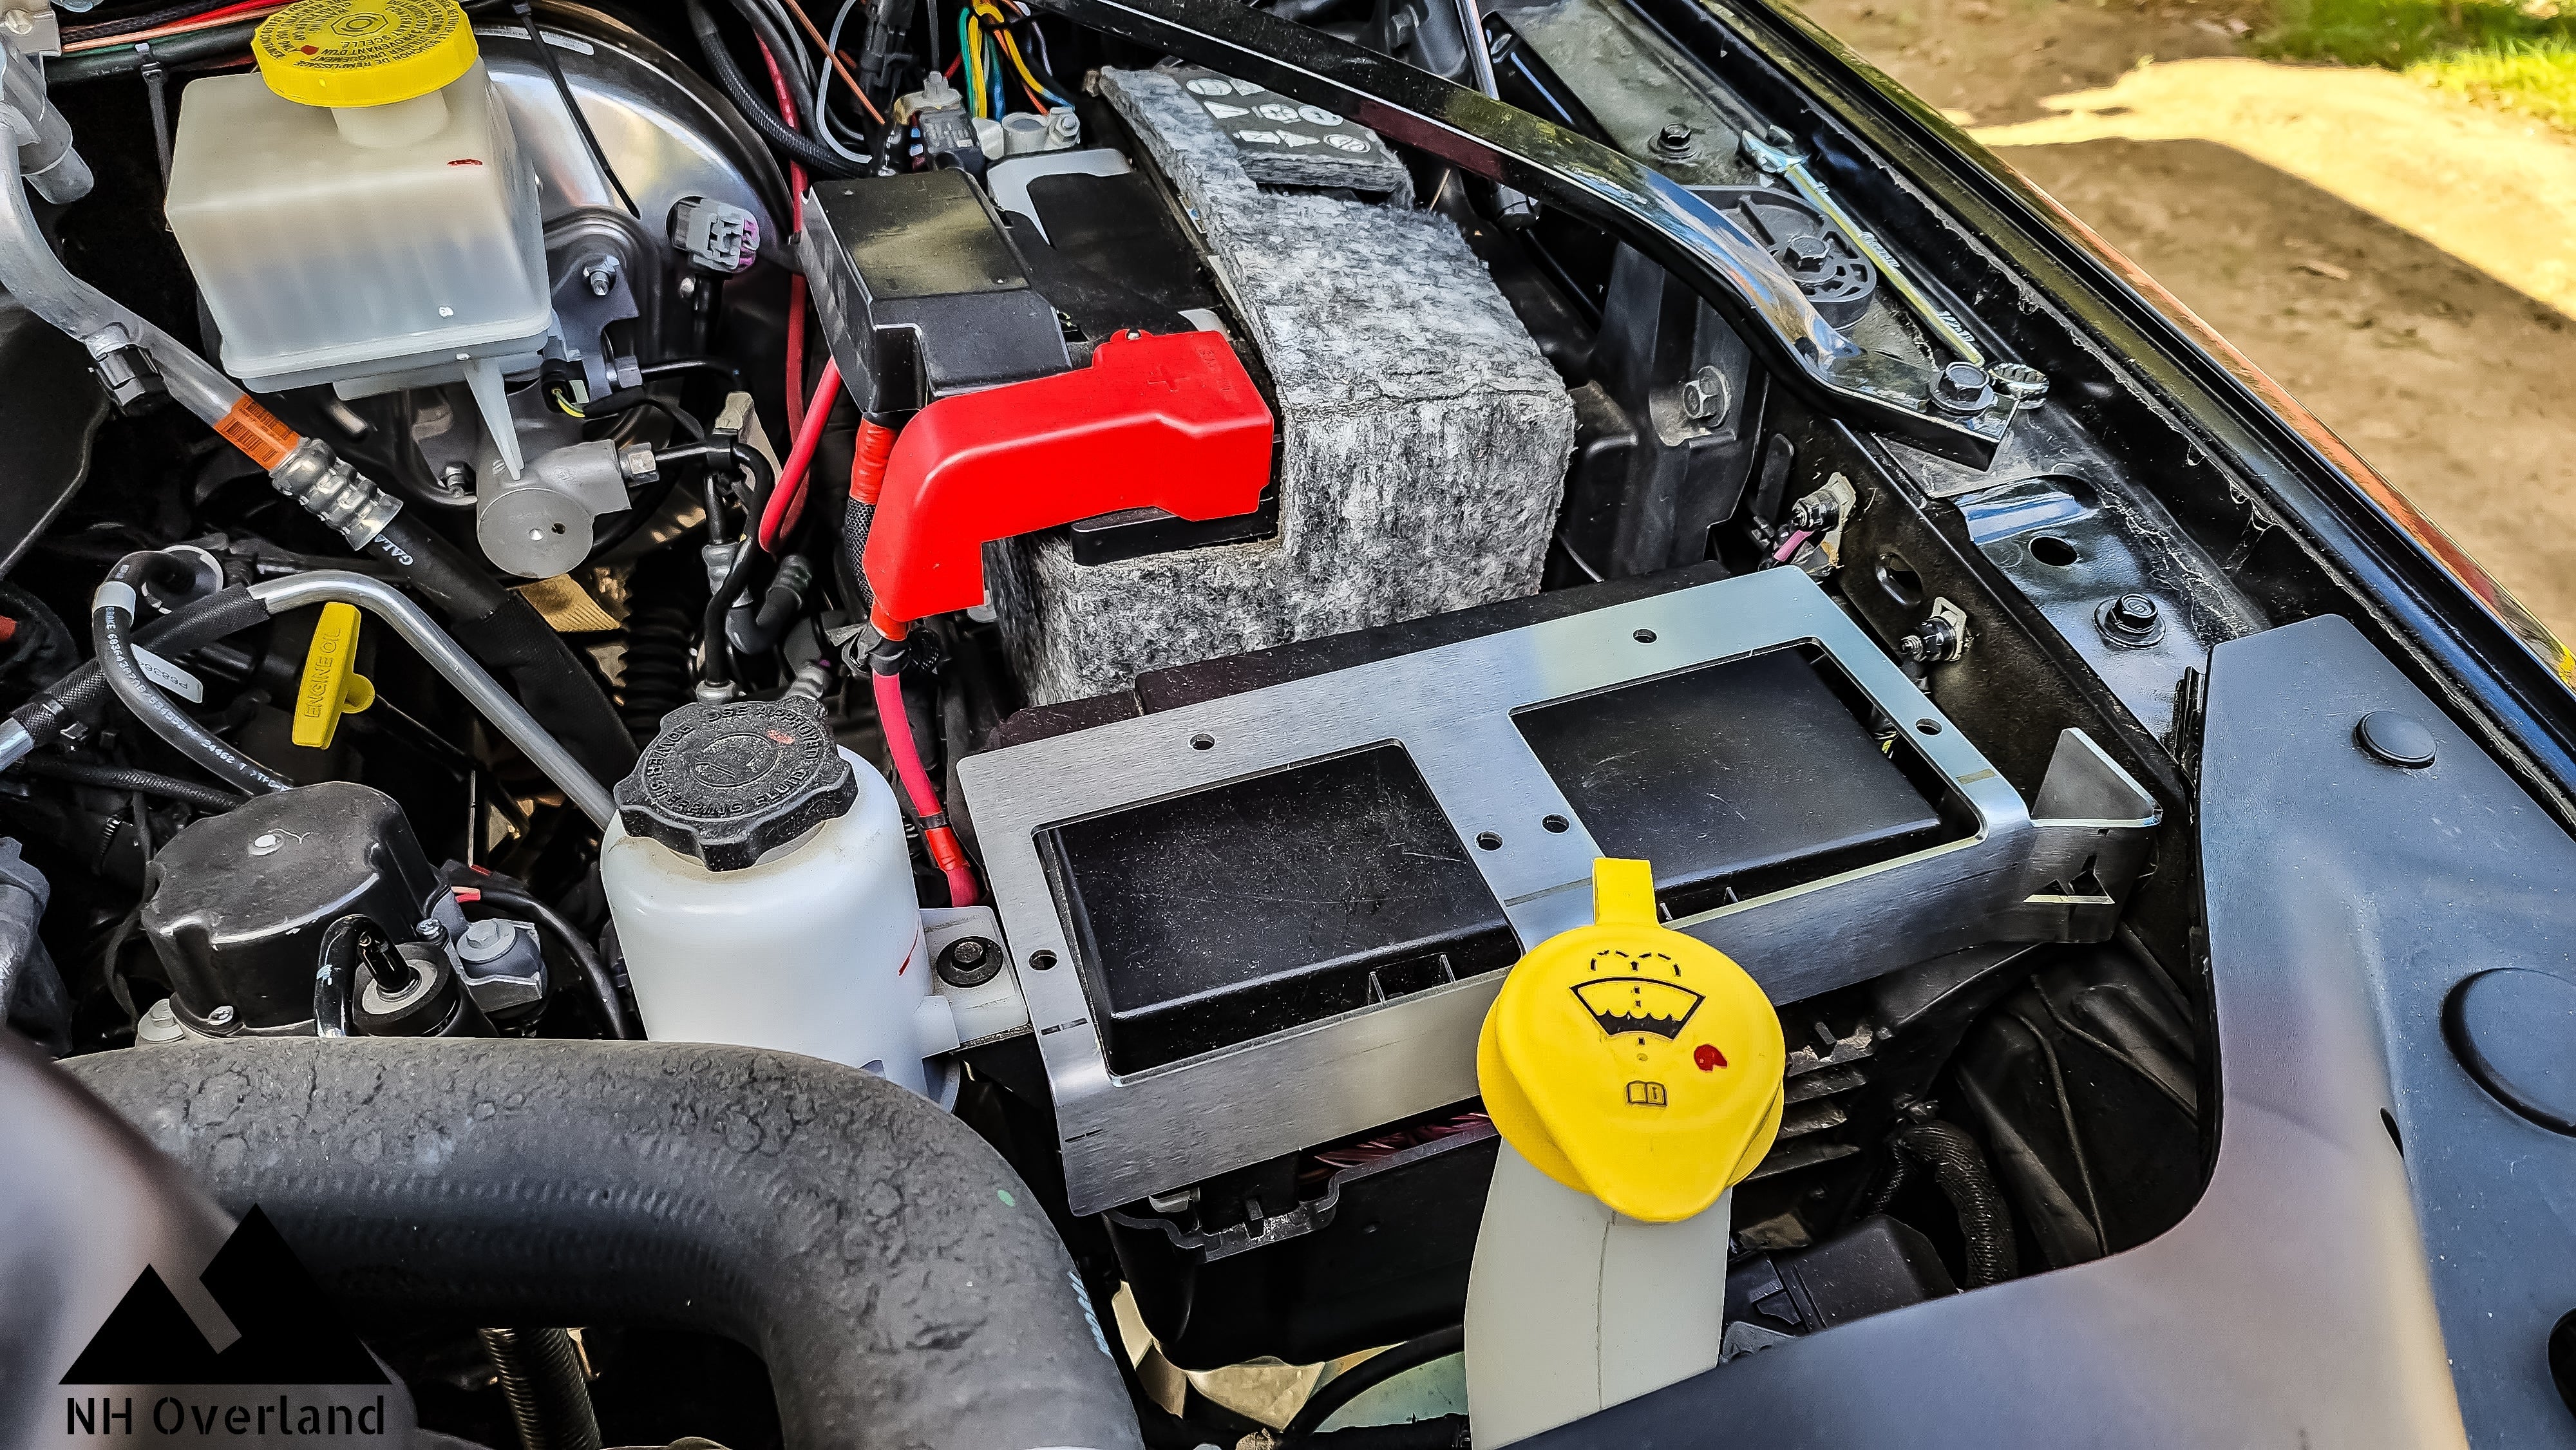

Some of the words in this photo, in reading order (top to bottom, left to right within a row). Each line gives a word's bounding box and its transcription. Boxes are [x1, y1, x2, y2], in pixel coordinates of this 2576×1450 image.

[261, 15, 285, 33] SEALED
[385, 6, 413, 37] CONTENANT
[414, 20, 429, 30] DOT
[276, 30, 290, 41] USE
[291, 31, 307, 41] CAP
[350, 33, 417, 53] PROVENANT
[388, 36, 431, 54] UTILISER
[278, 41, 302, 53] ONLY
[310, 52, 387, 62] UNIQUEMENT
[392, 40, 440, 61] BOUCHON
[294, 60, 372, 69] REMPLISSAGE
[106, 607, 117, 630] BRAKE
[305, 656, 333, 718] ENGINE
[319, 628, 341, 654] OIL
[705, 706, 748, 722] USE
[755, 707, 820, 761] APPROVED
[647, 724, 696, 778] POWER
[650, 779, 744, 816] STEERING
[756, 769, 809, 806] FLUID
